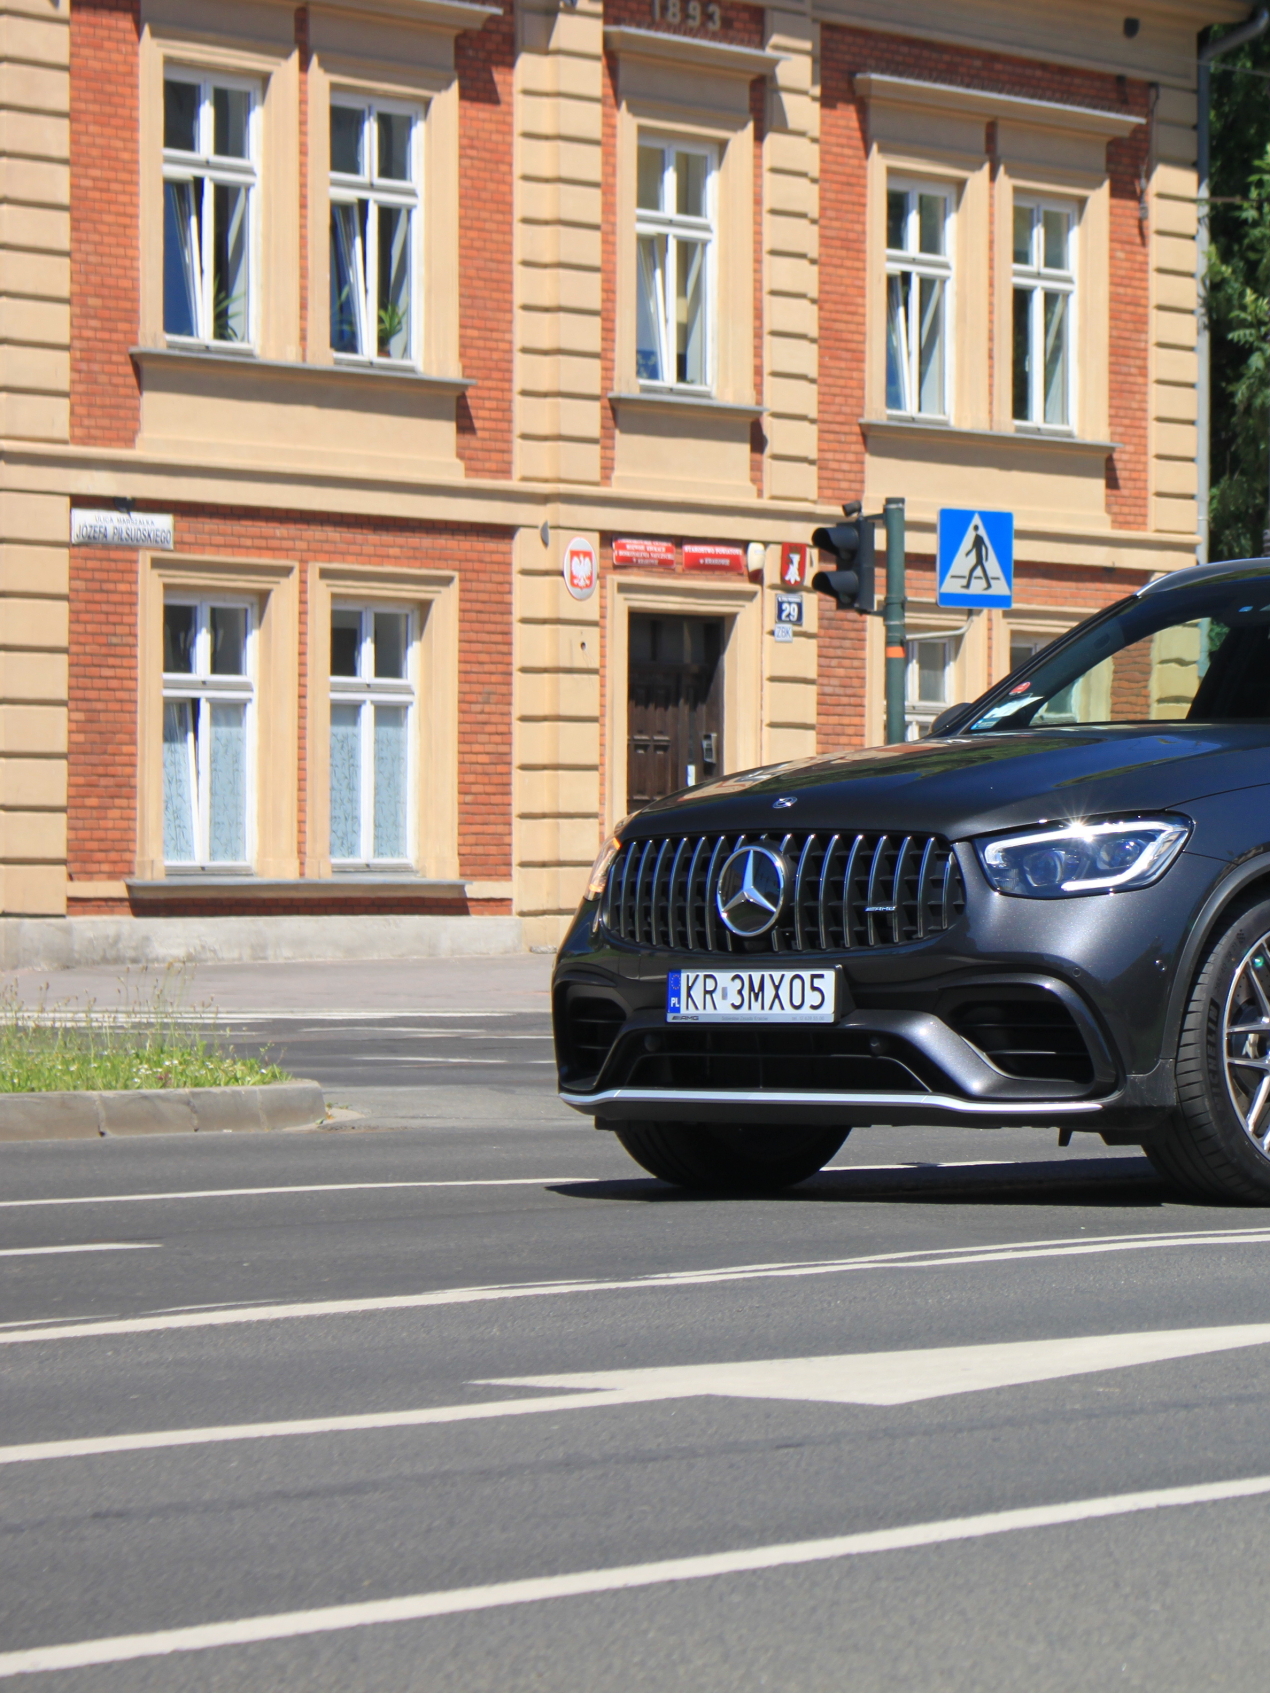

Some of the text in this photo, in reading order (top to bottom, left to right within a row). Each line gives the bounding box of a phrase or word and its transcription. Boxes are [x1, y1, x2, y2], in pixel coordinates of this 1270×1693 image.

[652, 0, 720, 31] 1893
[94, 515, 113, 524] ULICA
[76, 522, 172, 544] JÓZEFA PIŁSUDSKIEGO
[781, 603, 798, 621] 29
[686, 973, 825, 1010] KR 3MX05
[671, 997, 680, 1008] PL
